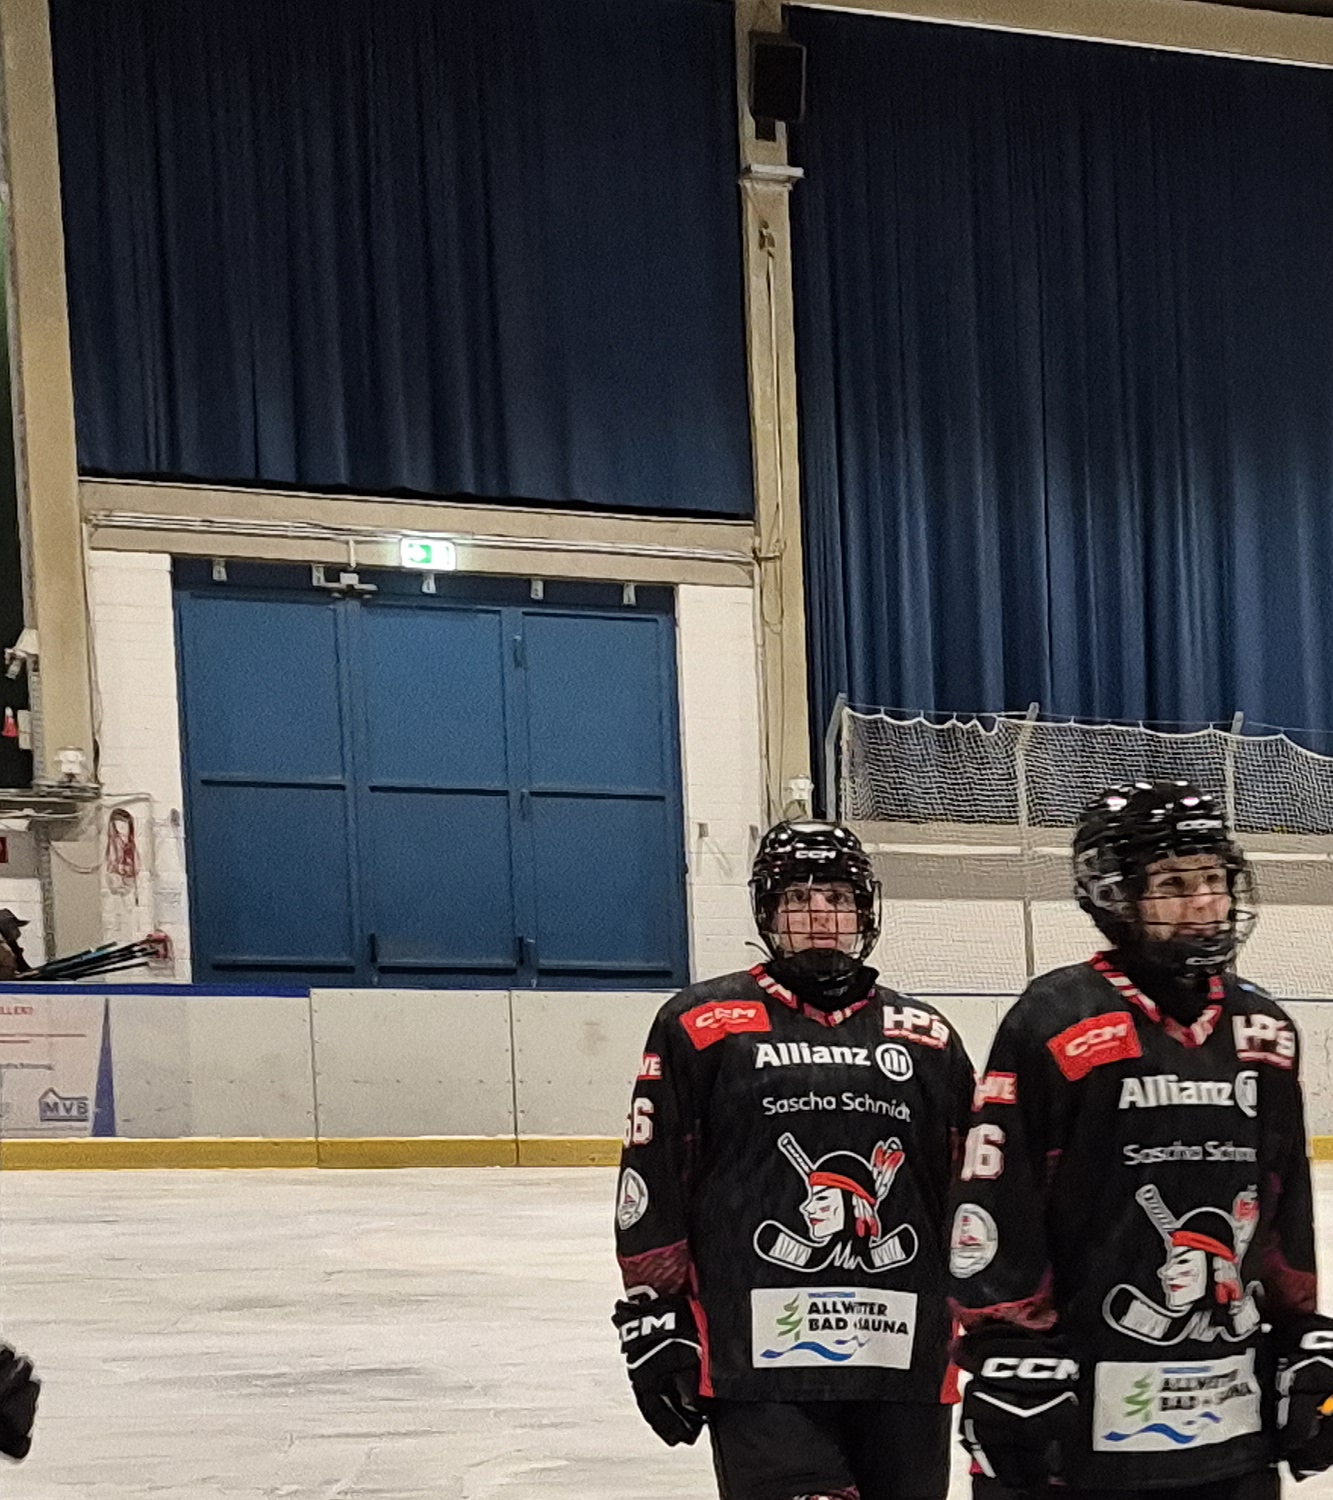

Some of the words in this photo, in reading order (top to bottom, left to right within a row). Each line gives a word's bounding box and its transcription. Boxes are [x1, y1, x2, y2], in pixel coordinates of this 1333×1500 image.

[755, 1043, 871, 1070] Allianz
[763, 1091, 837, 1117] Sascha
[1118, 1074, 1235, 1110] Allianz
[45, 1101, 88, 1115] MVB
[620, 1312, 676, 1343] CM
[808, 1317, 849, 1332] BAD
